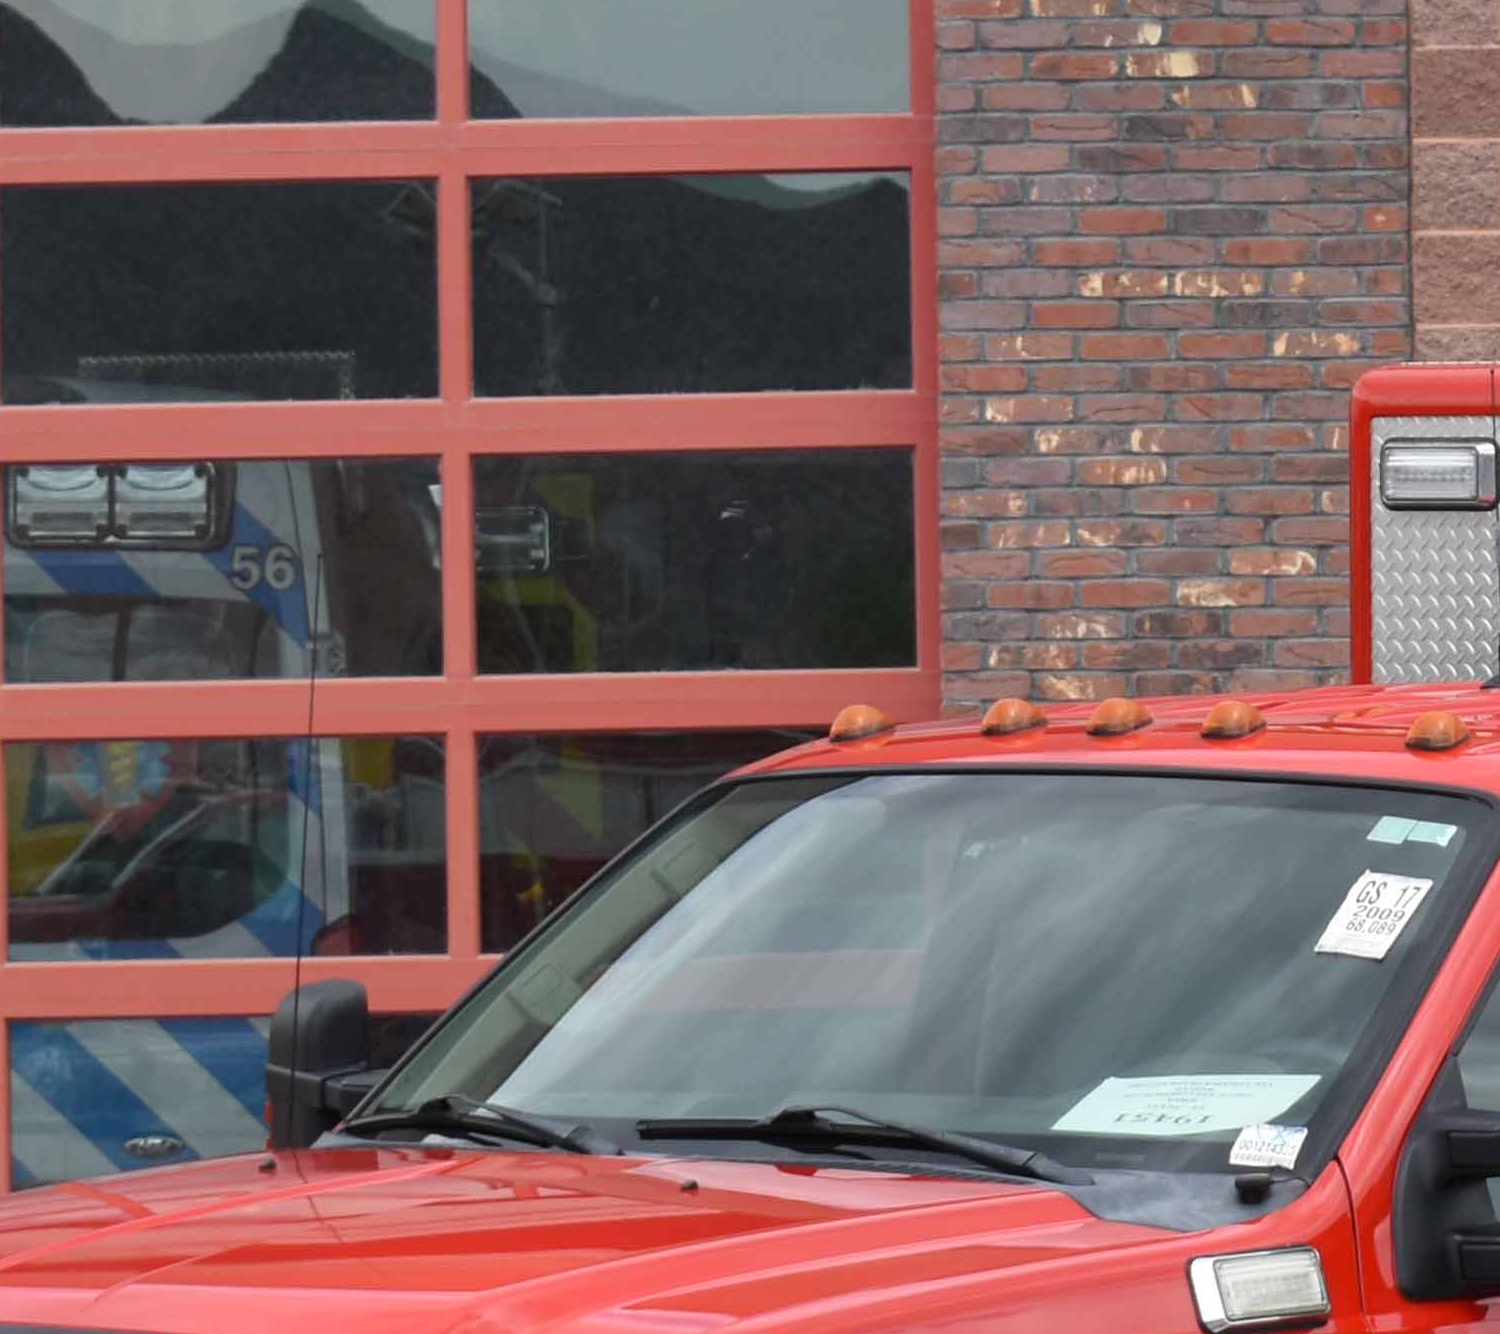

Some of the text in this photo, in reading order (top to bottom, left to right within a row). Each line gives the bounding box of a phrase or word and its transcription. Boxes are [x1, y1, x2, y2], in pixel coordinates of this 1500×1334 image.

[231, 545, 296, 590] 56
[1356, 880, 1388, 905] GS
[1352, 904, 1406, 922] 2009
